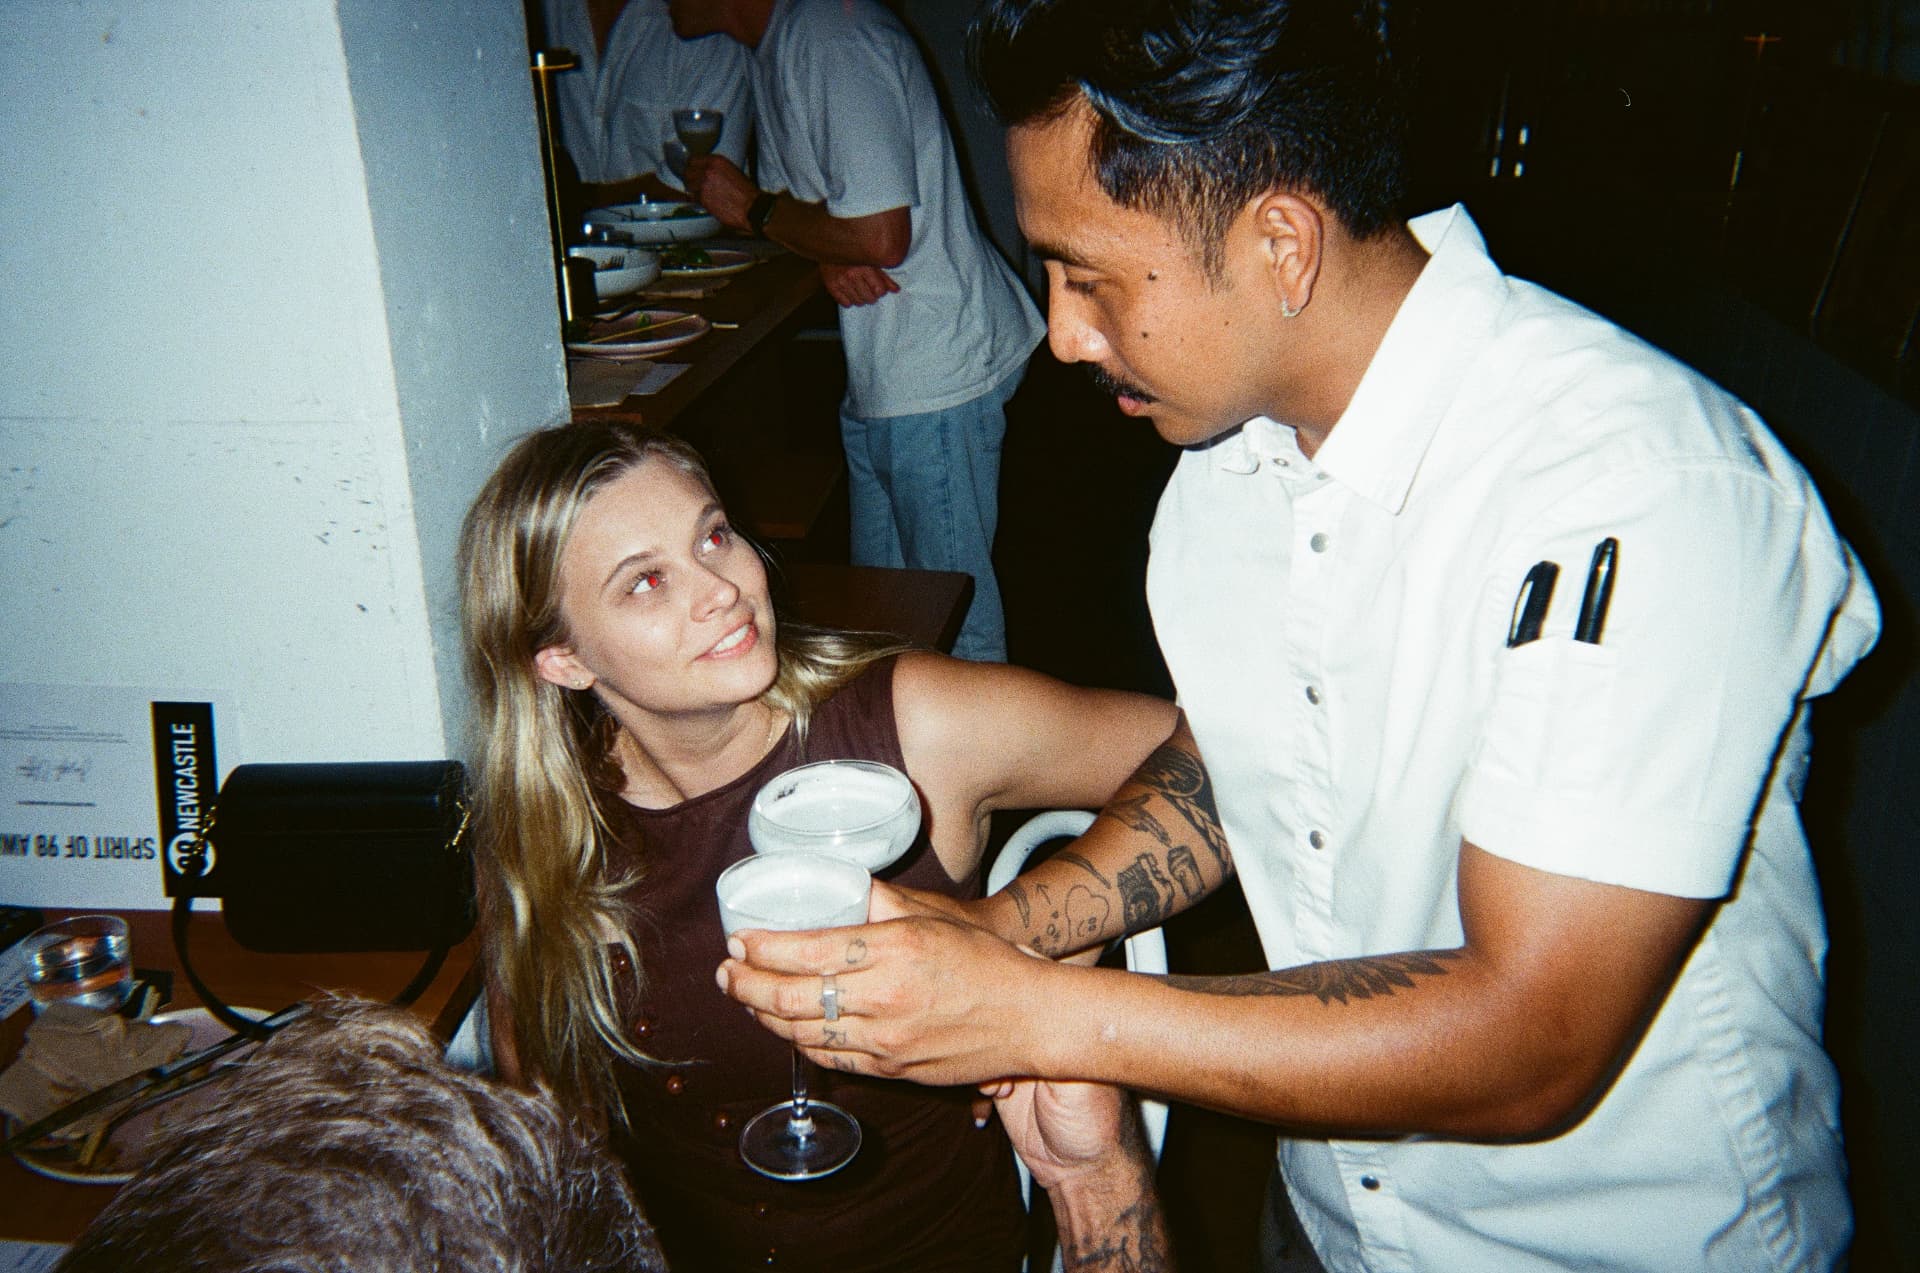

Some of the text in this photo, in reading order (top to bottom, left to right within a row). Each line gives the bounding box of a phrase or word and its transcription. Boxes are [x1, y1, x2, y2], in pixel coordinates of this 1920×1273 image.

[171, 723, 201, 829] NEWCASTLE
[34, 834, 60, 857] 98
[64, 835, 89, 858] OF
[94, 836, 156, 860] SPIRIT
